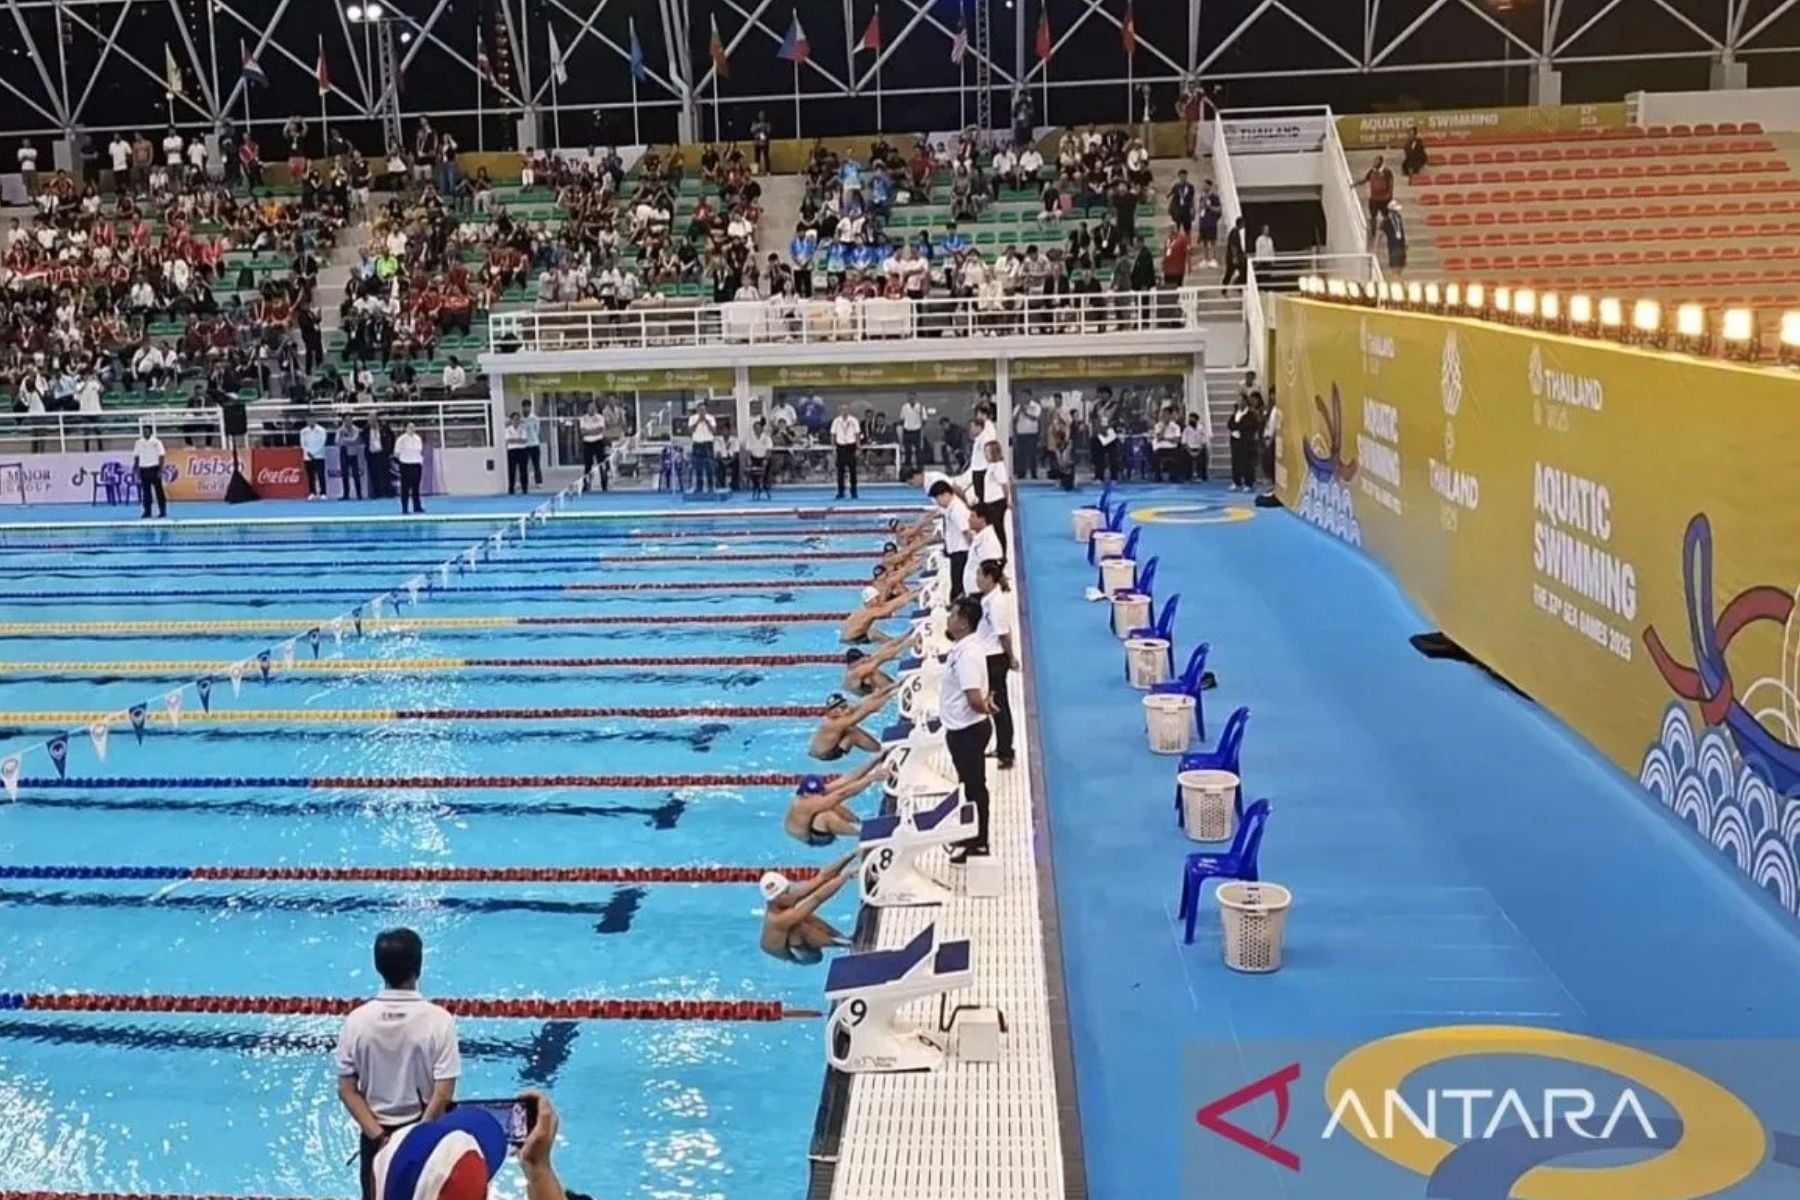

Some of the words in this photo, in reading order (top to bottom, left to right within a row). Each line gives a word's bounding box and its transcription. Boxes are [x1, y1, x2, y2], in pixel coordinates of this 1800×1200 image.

[1359, 117, 1415, 131] AQUATIC
[1428, 113, 1499, 129] SWIMMING
[1545, 369, 1603, 411] THAILAND
[7, 469, 51, 482] MAJOR
[1534, 461, 1611, 541] AQUATIC
[1534, 520, 1637, 621] SWIMMING
[924, 622, 933, 637] 5
[911, 676, 922, 693] 6
[900, 747, 911, 766] 7
[879, 847, 894, 870] 8
[850, 999, 867, 1027] 9
